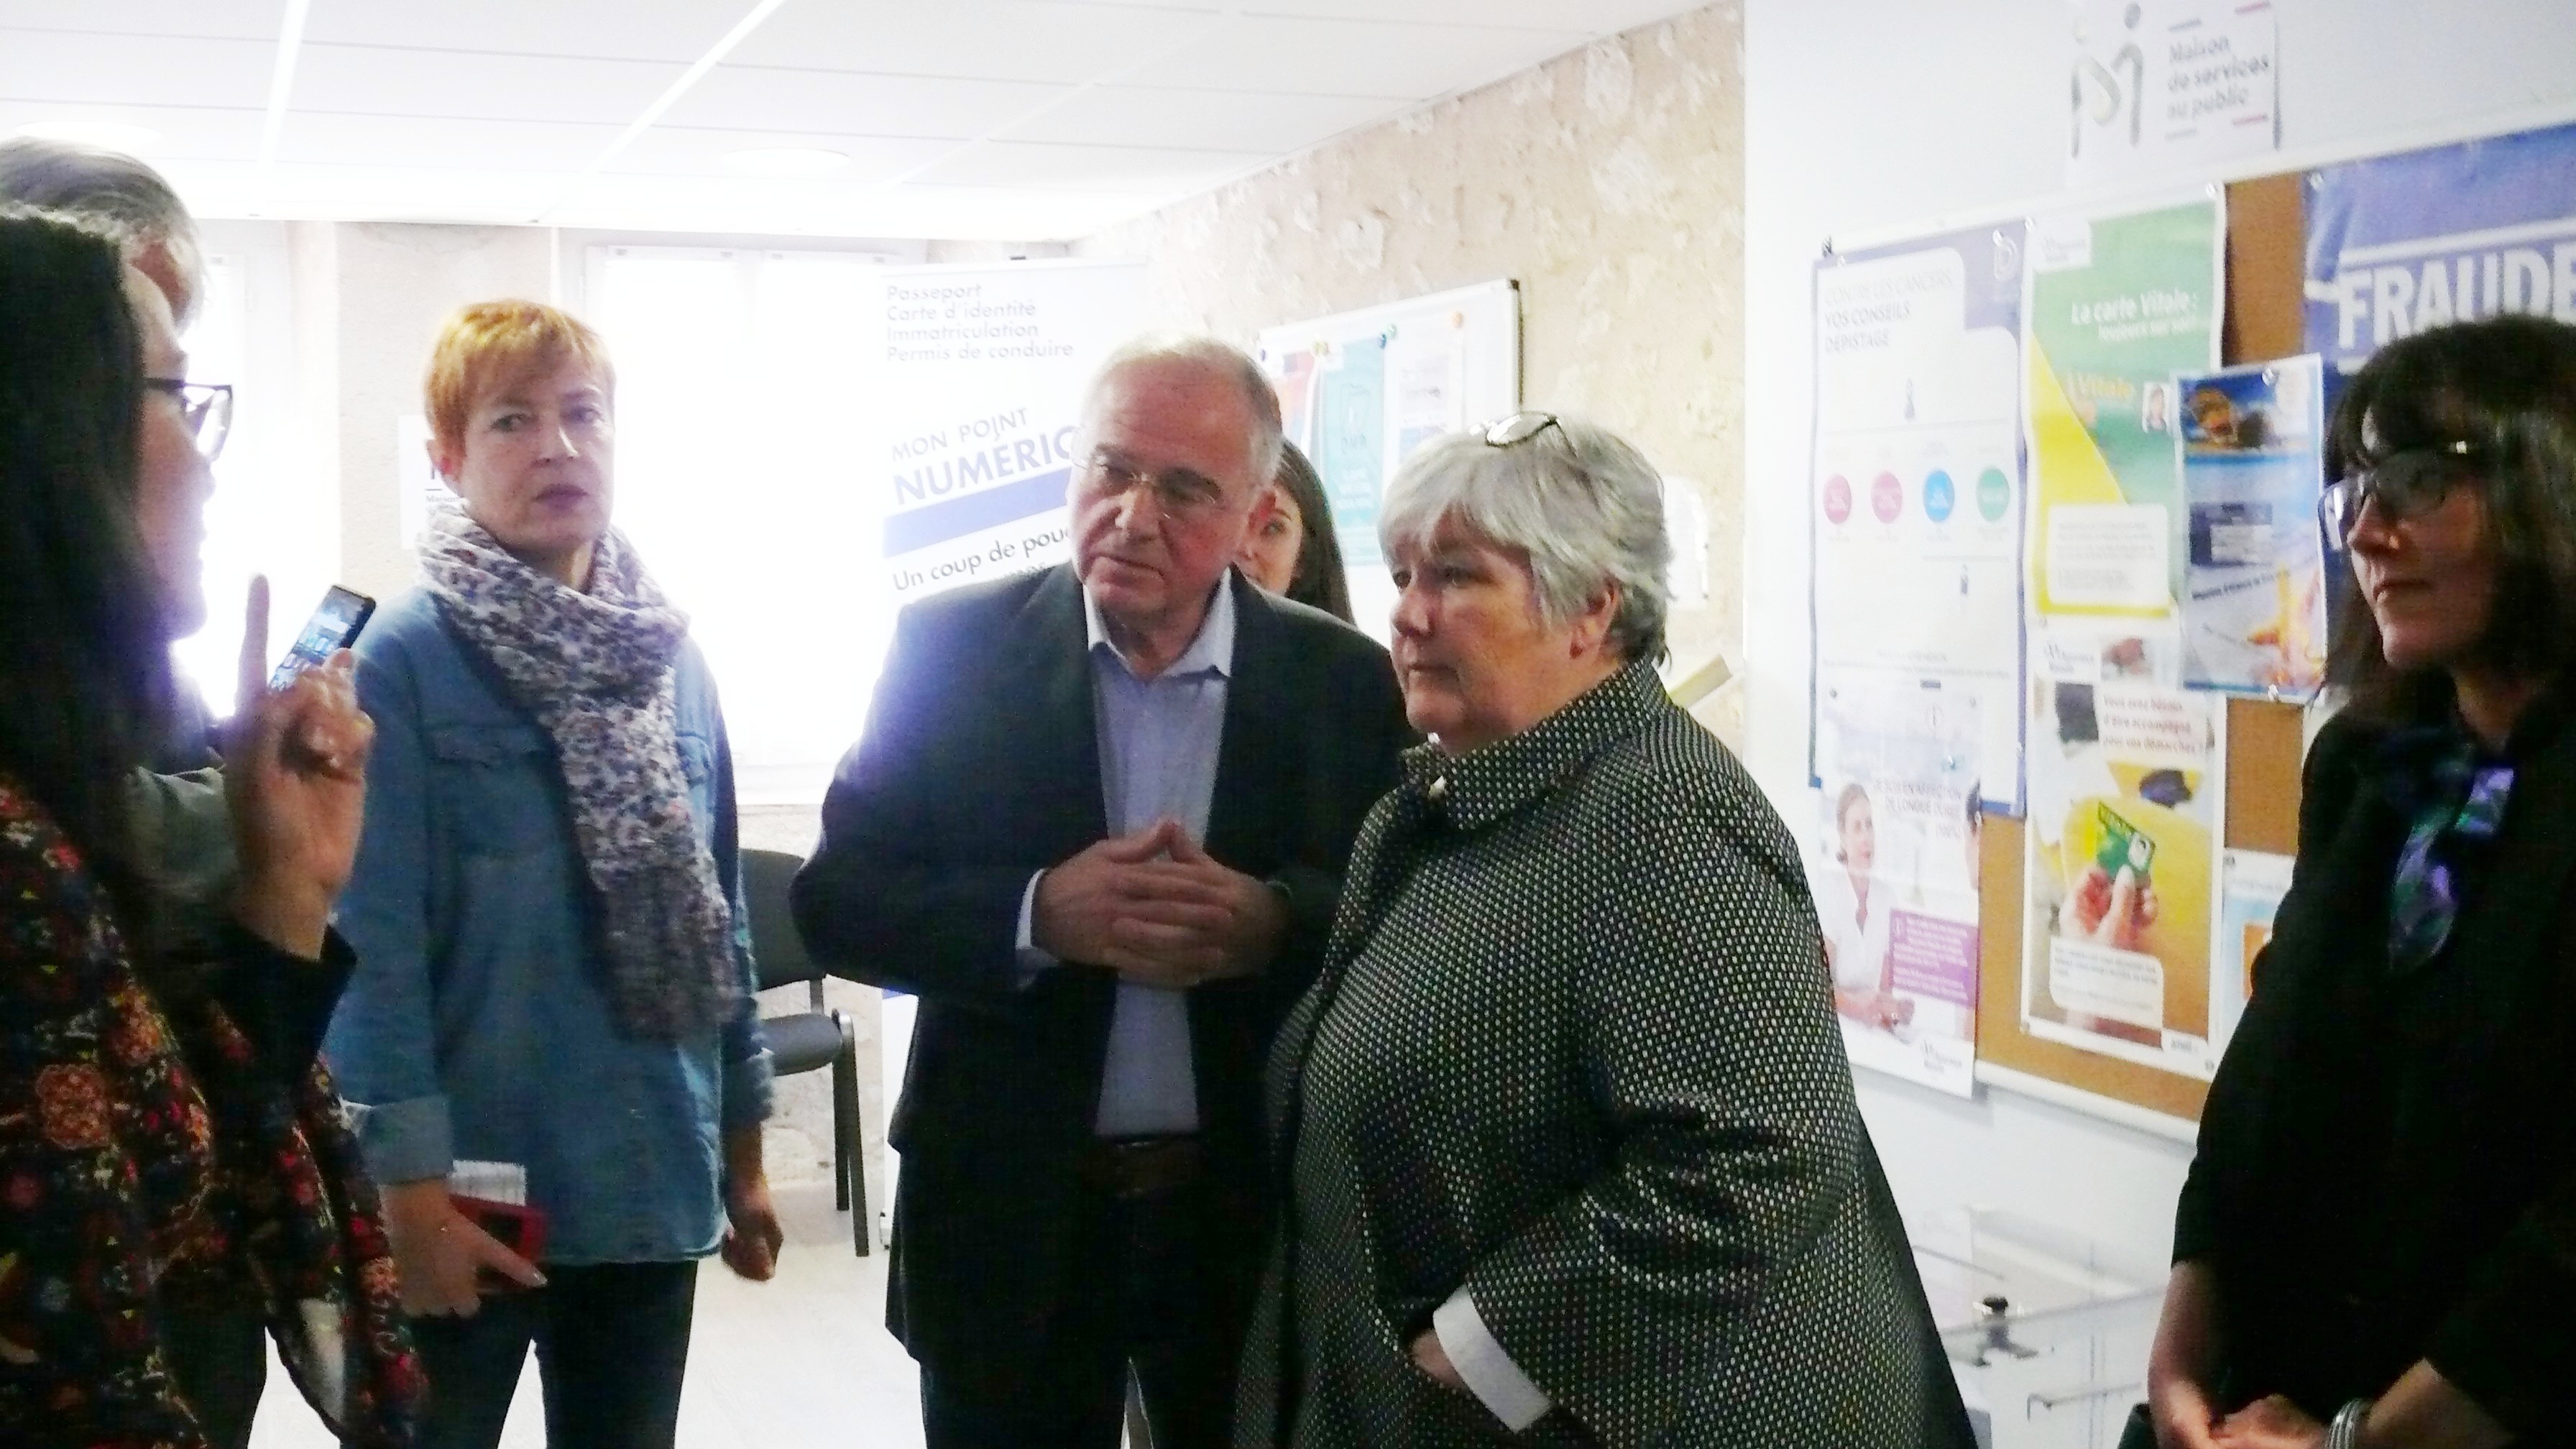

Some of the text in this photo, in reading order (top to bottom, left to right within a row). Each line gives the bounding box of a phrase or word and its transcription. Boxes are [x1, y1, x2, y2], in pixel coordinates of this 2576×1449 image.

[886, 283, 982, 303] Passeport
[886, 299, 1036, 321] Carte d'identité
[886, 321, 1039, 341] Immatriculation
[886, 339, 1074, 362] Permis de conduire
[891, 407, 1029, 461] MON POINT
[892, 569, 924, 591] Un
[930, 553, 982, 579] coup
[988, 539, 1016, 562] de
